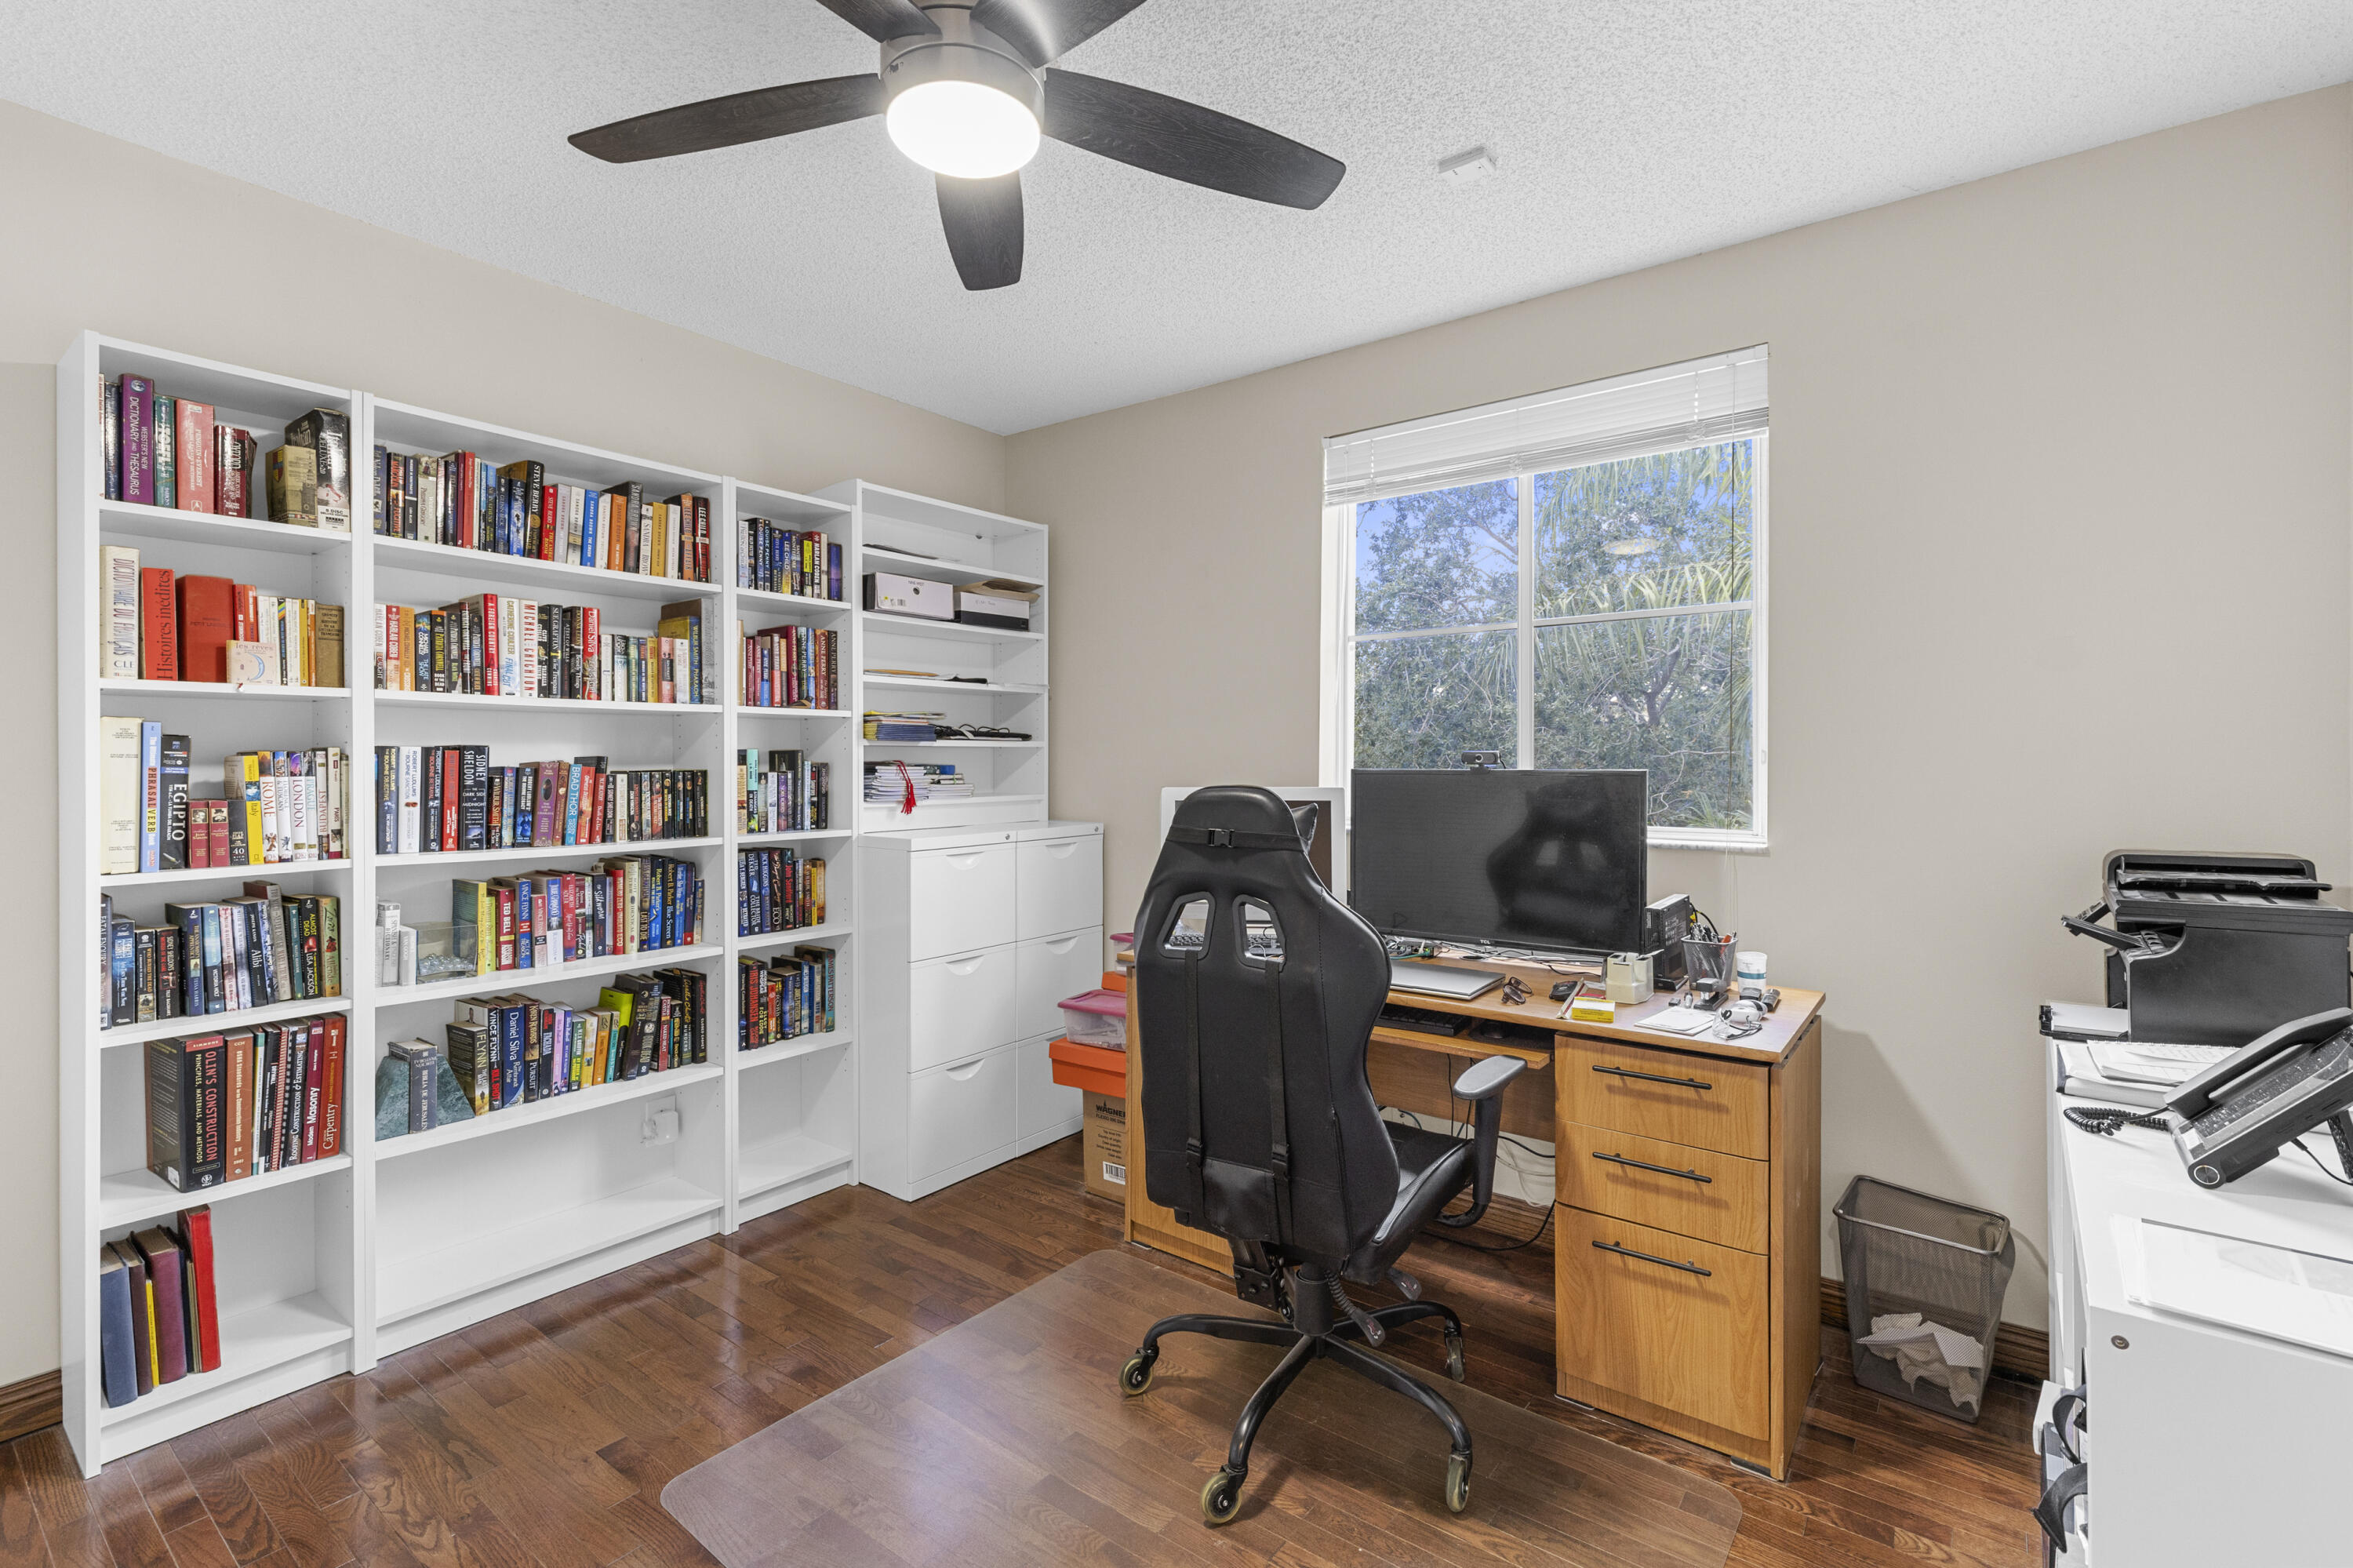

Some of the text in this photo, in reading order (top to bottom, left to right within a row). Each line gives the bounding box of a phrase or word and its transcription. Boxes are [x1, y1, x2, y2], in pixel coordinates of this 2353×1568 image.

[129, 397, 139, 442] DICTIONARY
[130, 453, 140, 494] THESAURUS
[631, 485, 640, 508] SANDRA
[114, 608, 134, 618] DU
[154, 570, 173, 679] Histoires inédites
[524, 604, 535, 641] MICHAEL
[551, 650, 560, 659] T
[464, 751, 474, 784] SHELDON
[476, 755, 486, 780] SIDNEY
[147, 767, 157, 832] PHRASAL VERB
[263, 782, 278, 817] ROME
[293, 780, 304, 828] LONDON
[569, 767, 580, 815] BRAD THOR
[173, 784, 187, 841] EGIPTO
[252, 950, 260, 967] Alibi
[477, 1035, 486, 1068] FLYNN
[510, 1013, 518, 1060] Daniel Silva
[543, 1032, 552, 1055] FACHADA
[294, 1051, 304, 1083] ESTIMATING
[205, 1051, 216, 1161] OLIN'S CONSTRUCTION
[291, 1092, 301, 1133] CONSTRUCTION
[307, 1087, 320, 1123] Masonry
[323, 1104, 338, 1149] Carpentry
[289, 1135, 299, 1160] ROOFING
